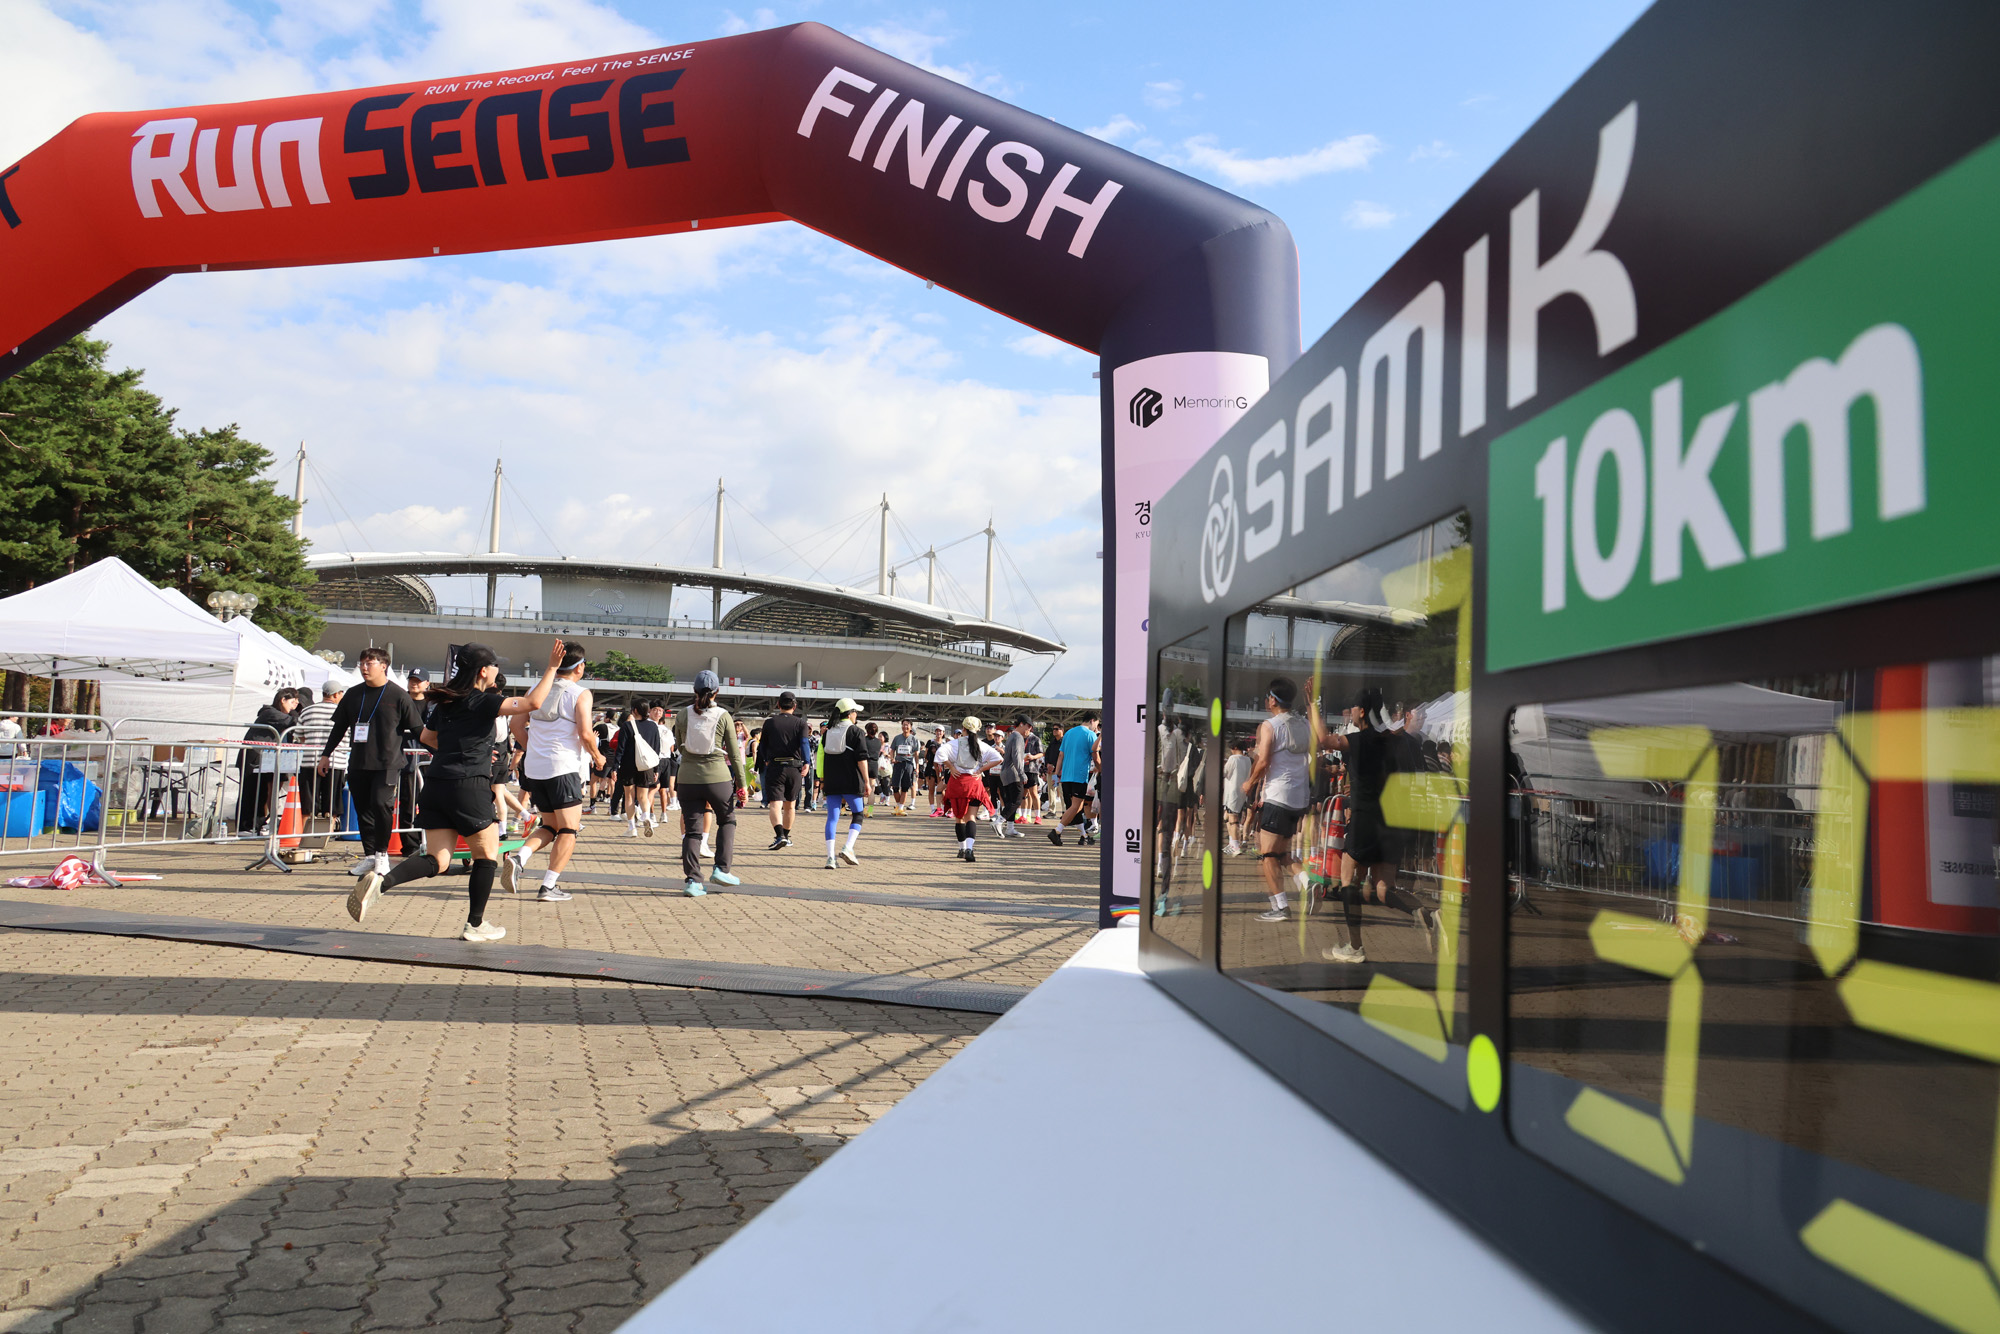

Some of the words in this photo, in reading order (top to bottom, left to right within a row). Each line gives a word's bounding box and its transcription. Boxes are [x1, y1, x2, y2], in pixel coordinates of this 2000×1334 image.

[424, 83, 460, 96] RUN
[464, 79, 492, 91] The
[496, 70, 555, 86] Record,
[561, 63, 598, 78] Feel
[602, 59, 633, 72] The
[636, 48, 696, 67] SENSE
[797, 65, 1124, 259] FINISH
[1173, 395, 1248, 410] MemorinG
[1243, 99, 1638, 563] SAMIK
[1534, 321, 1927, 615] 10km
